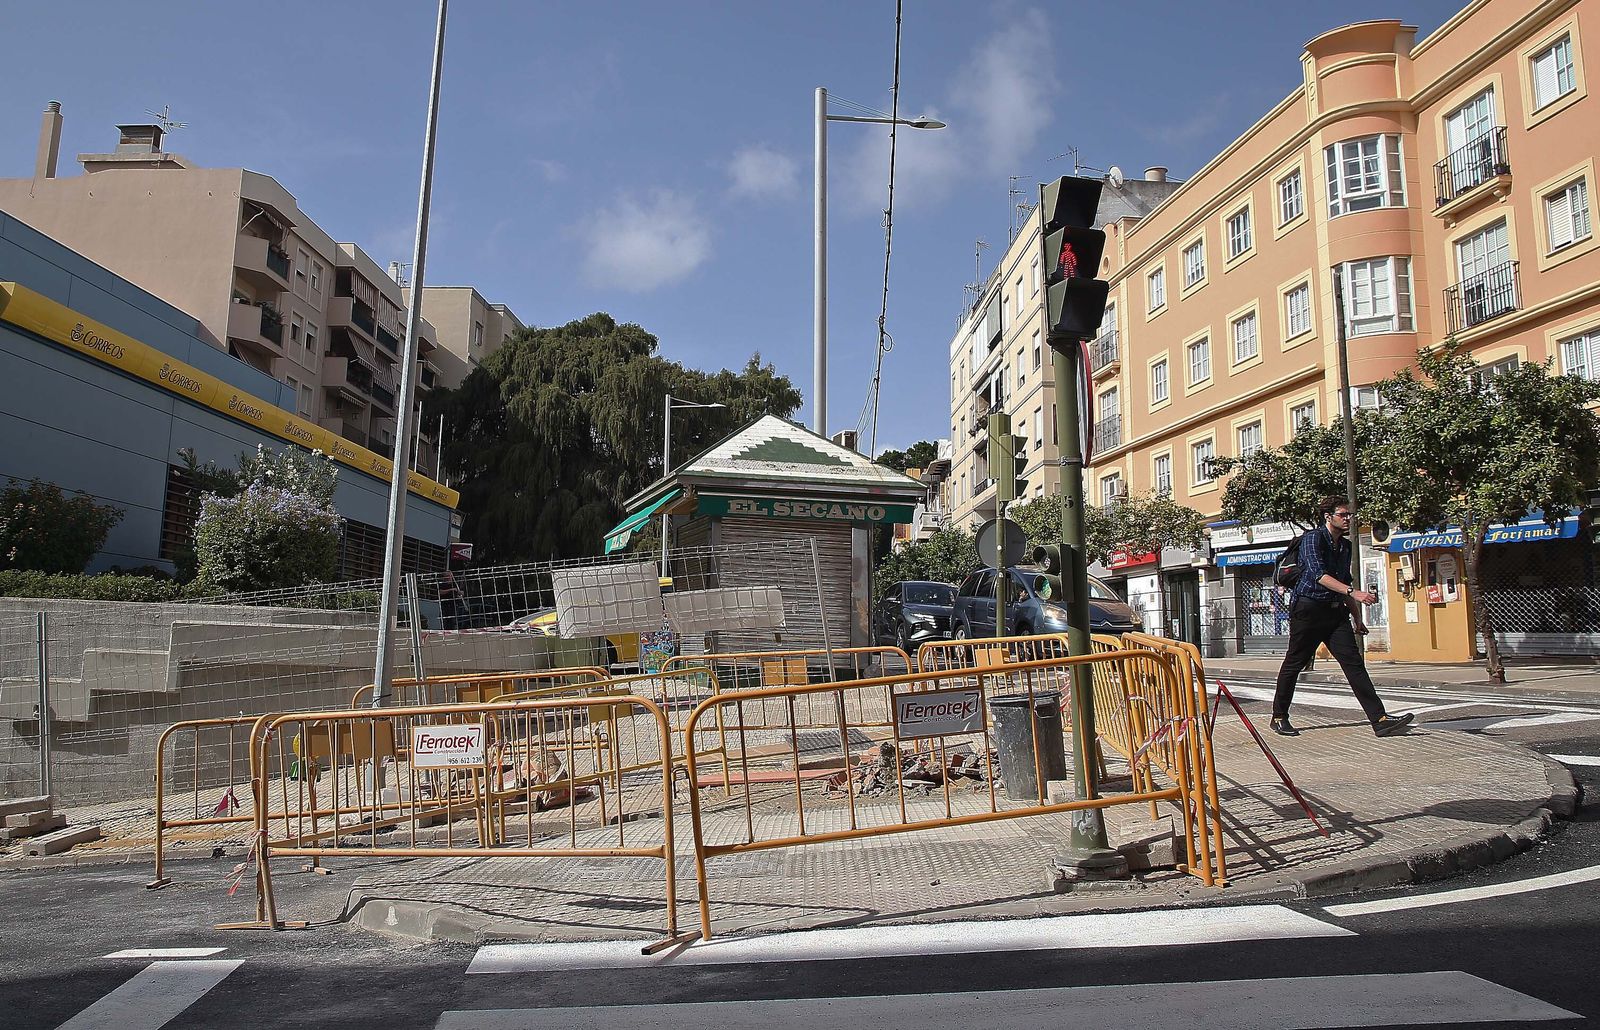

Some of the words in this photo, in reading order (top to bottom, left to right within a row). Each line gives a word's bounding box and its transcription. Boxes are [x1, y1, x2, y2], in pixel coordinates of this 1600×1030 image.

[83, 331, 125, 359] CORREOS
[168, 369, 202, 393] CORREOS
[727, 500, 768, 515] EL
[773, 502, 886, 521] SECANO
[1255, 524, 1281, 536] Apuestas
[1402, 534, 1465, 550] CHIMENE
[905, 701, 974, 718] Ferrotek
[419, 734, 476, 752] Ferrotek
